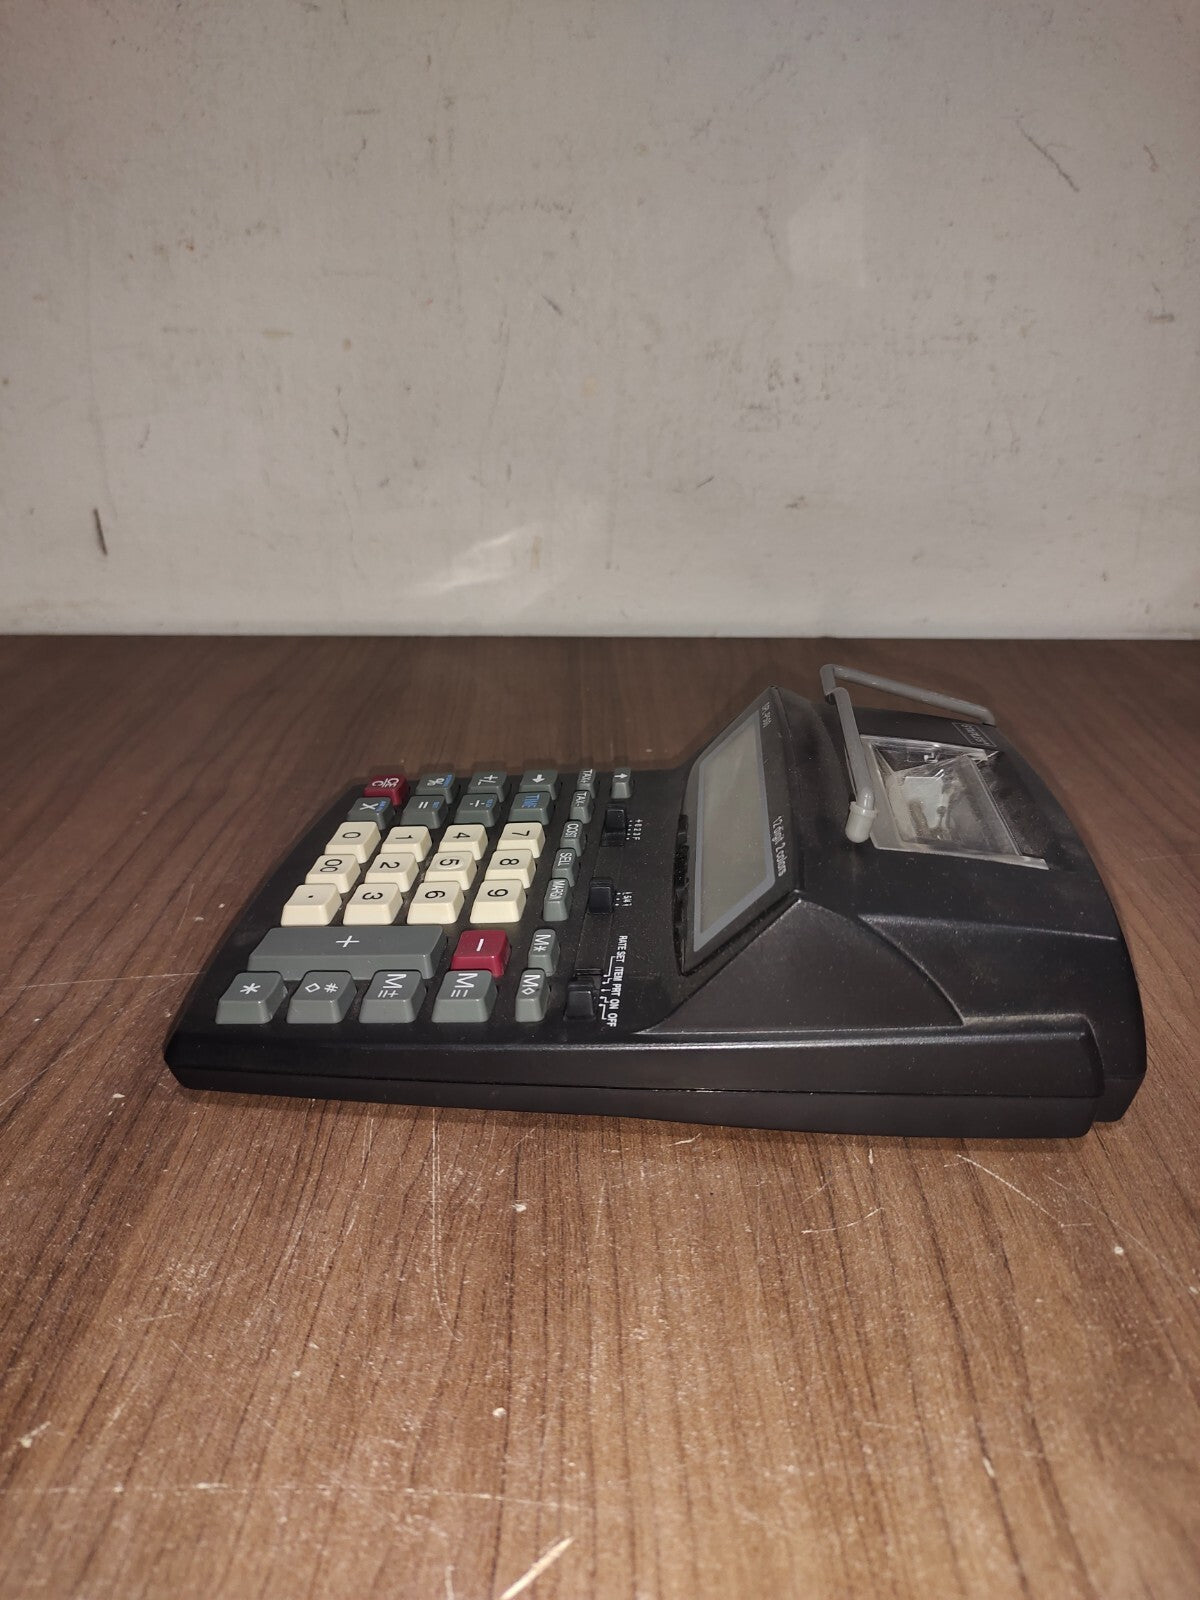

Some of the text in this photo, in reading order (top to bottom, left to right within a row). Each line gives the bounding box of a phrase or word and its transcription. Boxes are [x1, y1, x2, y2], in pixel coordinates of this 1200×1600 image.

[342, 831, 361, 839] 0
[564, 823, 579, 838] COST
[439, 858, 460, 866] 5
[499, 858, 520, 866] 8
[557, 852, 573, 867] SELL
[320, 858, 343, 873] 00
[379, 861, 400, 869] 2
[362, 892, 384, 900] 3
[424, 890, 446, 899] 6
[487, 888, 509, 898] 9
[605, 935, 628, 1027] RATE SET ITEM PRT ON OFF
